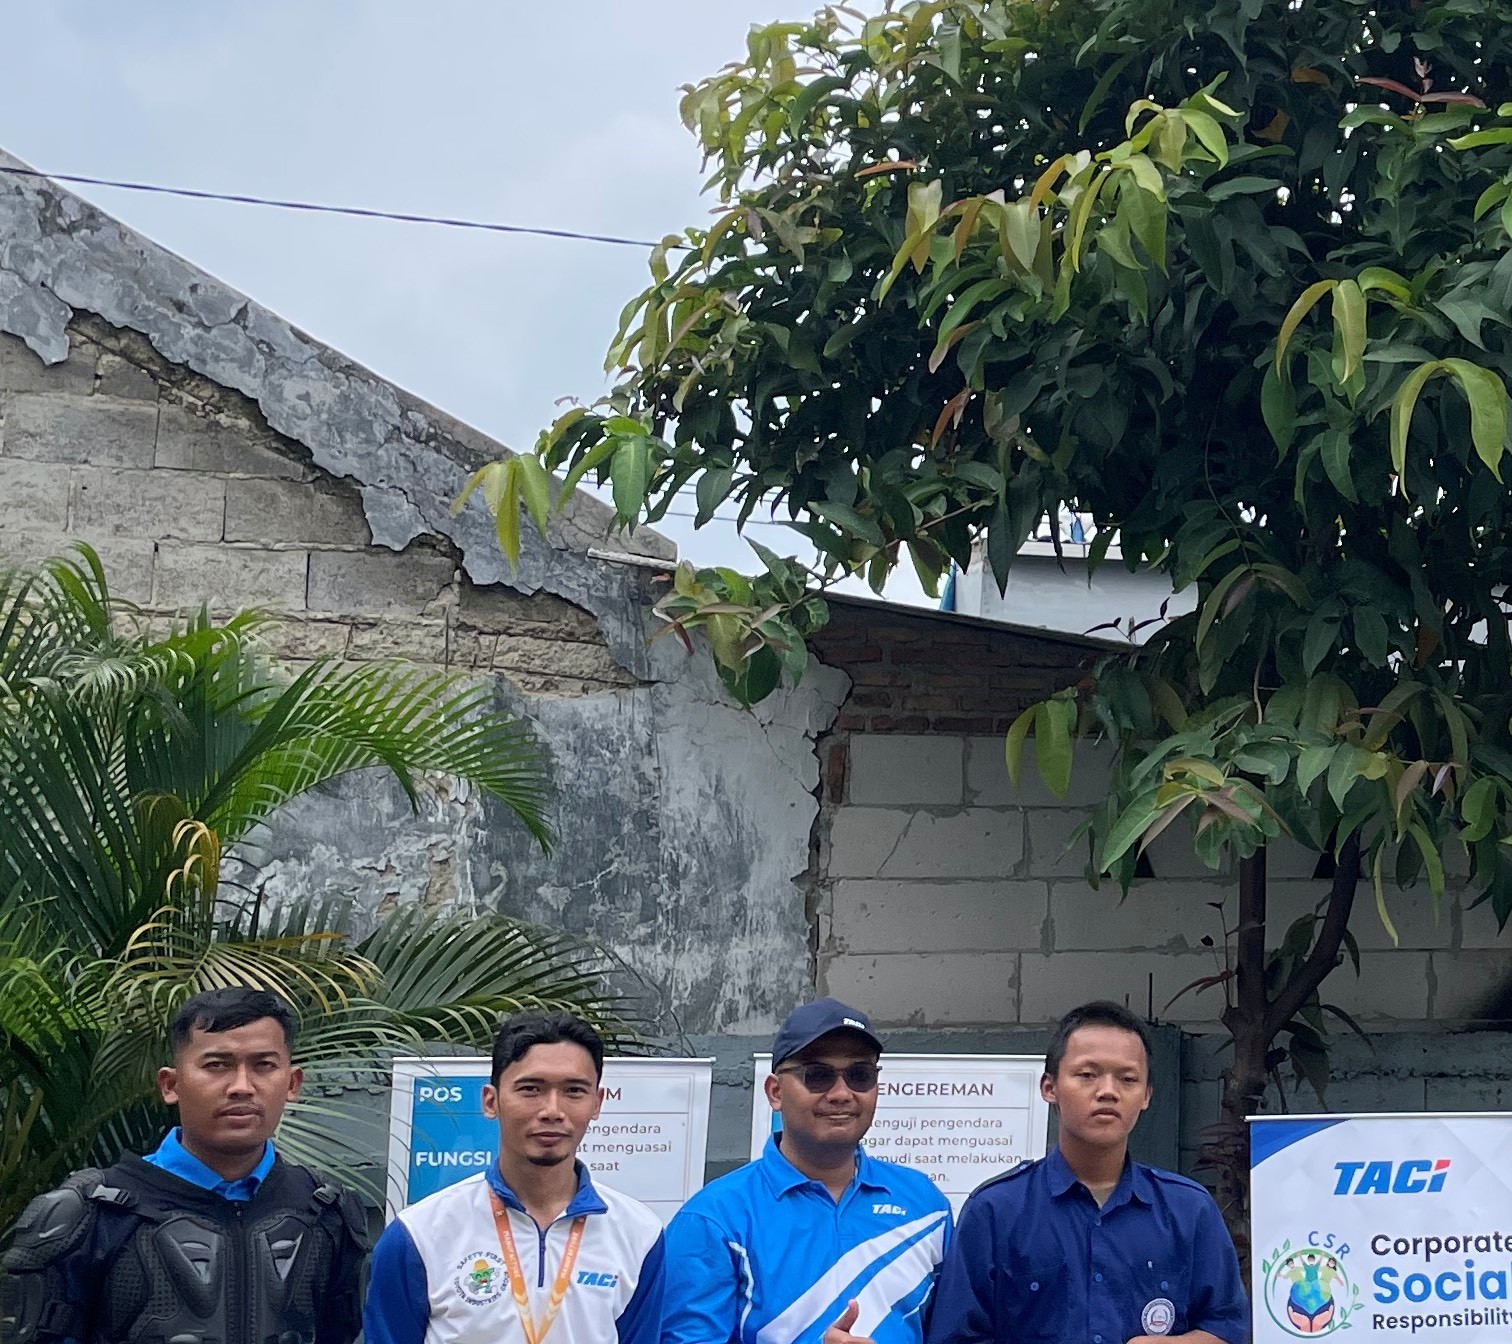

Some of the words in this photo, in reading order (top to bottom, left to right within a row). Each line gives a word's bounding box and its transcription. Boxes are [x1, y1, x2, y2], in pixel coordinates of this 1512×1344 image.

[420, 1087, 462, 1102] POS
[877, 1083, 994, 1096] ENGEREMAN
[872, 1117, 917, 1131] enguji
[921, 1118, 1003, 1131] pengendara
[592, 1140, 672, 1155] menguasai
[895, 1135, 934, 1147] dapat
[938, 1135, 1013, 1148] menguasai
[416, 1151, 492, 1166] FUNGSI
[870, 1153, 912, 1164] mudi
[915, 1154, 943, 1164] saat
[947, 1153, 1021, 1164] melakukan
[590, 1161, 620, 1171] saat
[1308, 1230, 1351, 1261] CSR
